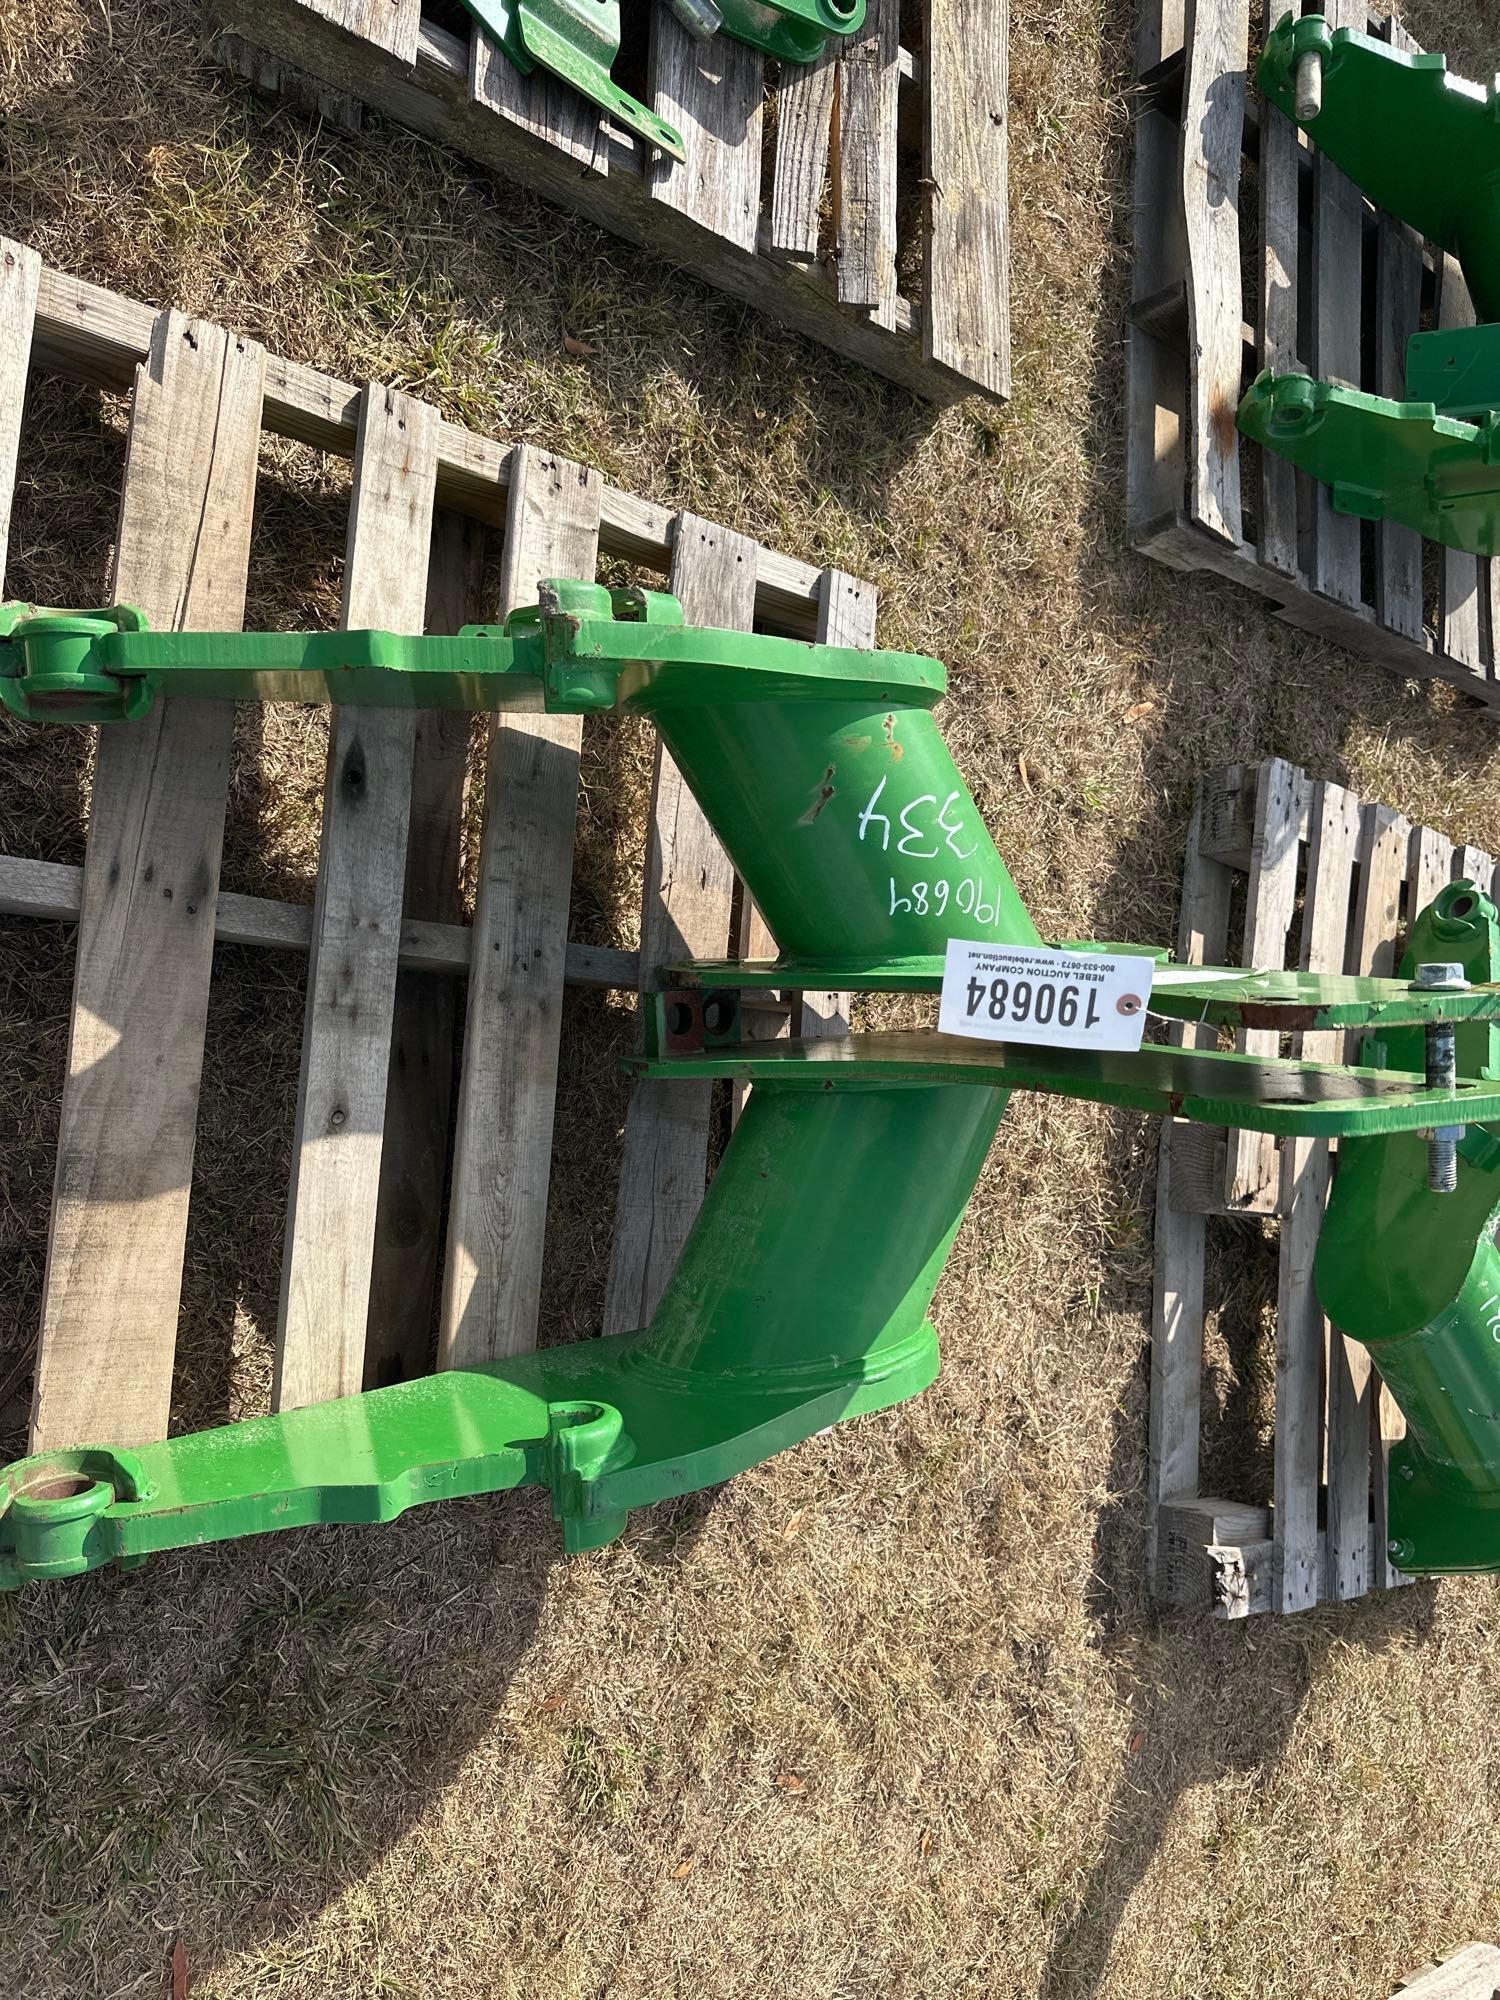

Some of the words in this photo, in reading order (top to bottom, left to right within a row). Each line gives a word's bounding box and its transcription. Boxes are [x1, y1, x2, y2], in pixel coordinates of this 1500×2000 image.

[858, 774, 979, 859] 334
[889, 876, 1001, 927] 190684
[968, 951, 1055, 966] www.rebelauction.net
[974, 962, 1024, 975] COMPANY
[1027, 968, 1069, 979] AUCTION
[1061, 961, 1115, 972] 800-533-0673
[1072, 972, 1105, 982] REBEL
[966, 976, 1100, 1029] 190684
